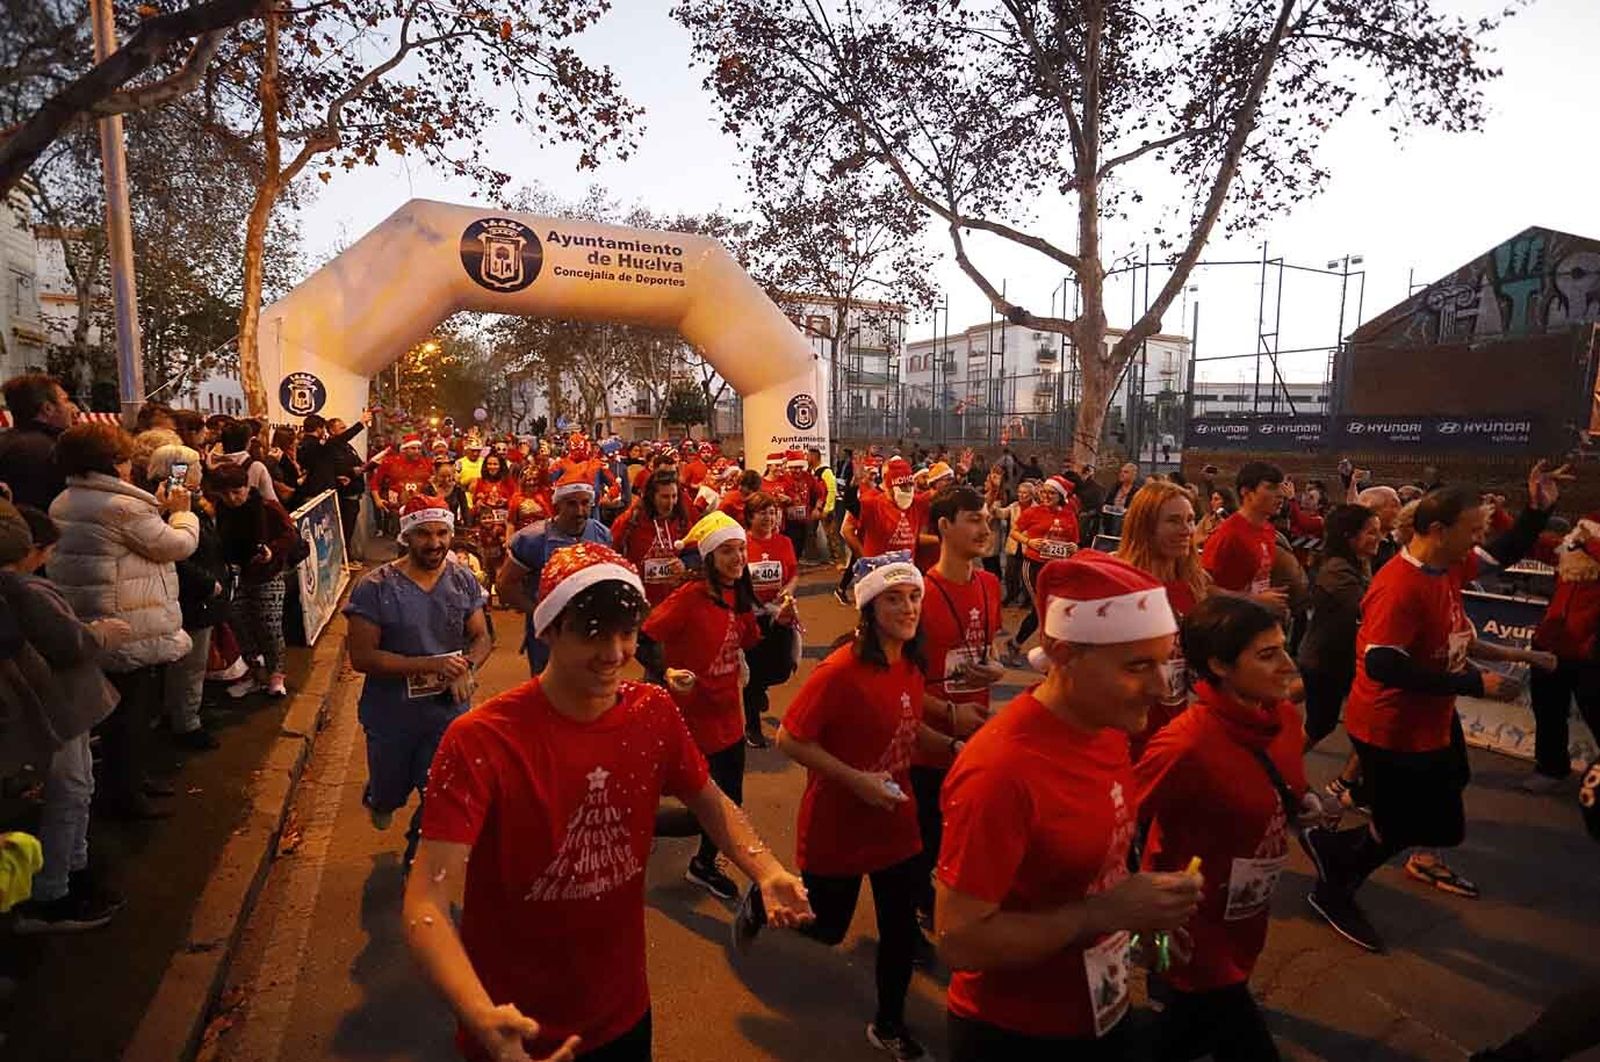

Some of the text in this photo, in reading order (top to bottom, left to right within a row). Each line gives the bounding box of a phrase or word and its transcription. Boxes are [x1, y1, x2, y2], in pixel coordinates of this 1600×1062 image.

[546, 230, 683, 257] Ayuntamiento
[587, 250, 683, 273] de Huelva
[618, 272, 632, 283] de
[635, 274, 685, 288] Deportes
[1210, 425, 1249, 434] HYUNDAI
[1276, 424, 1322, 434] HYUNDAI
[1368, 423, 1422, 434] HYUNDAI
[1463, 422, 1530, 434] HYUNDAI
[761, 569, 779, 579] 404
